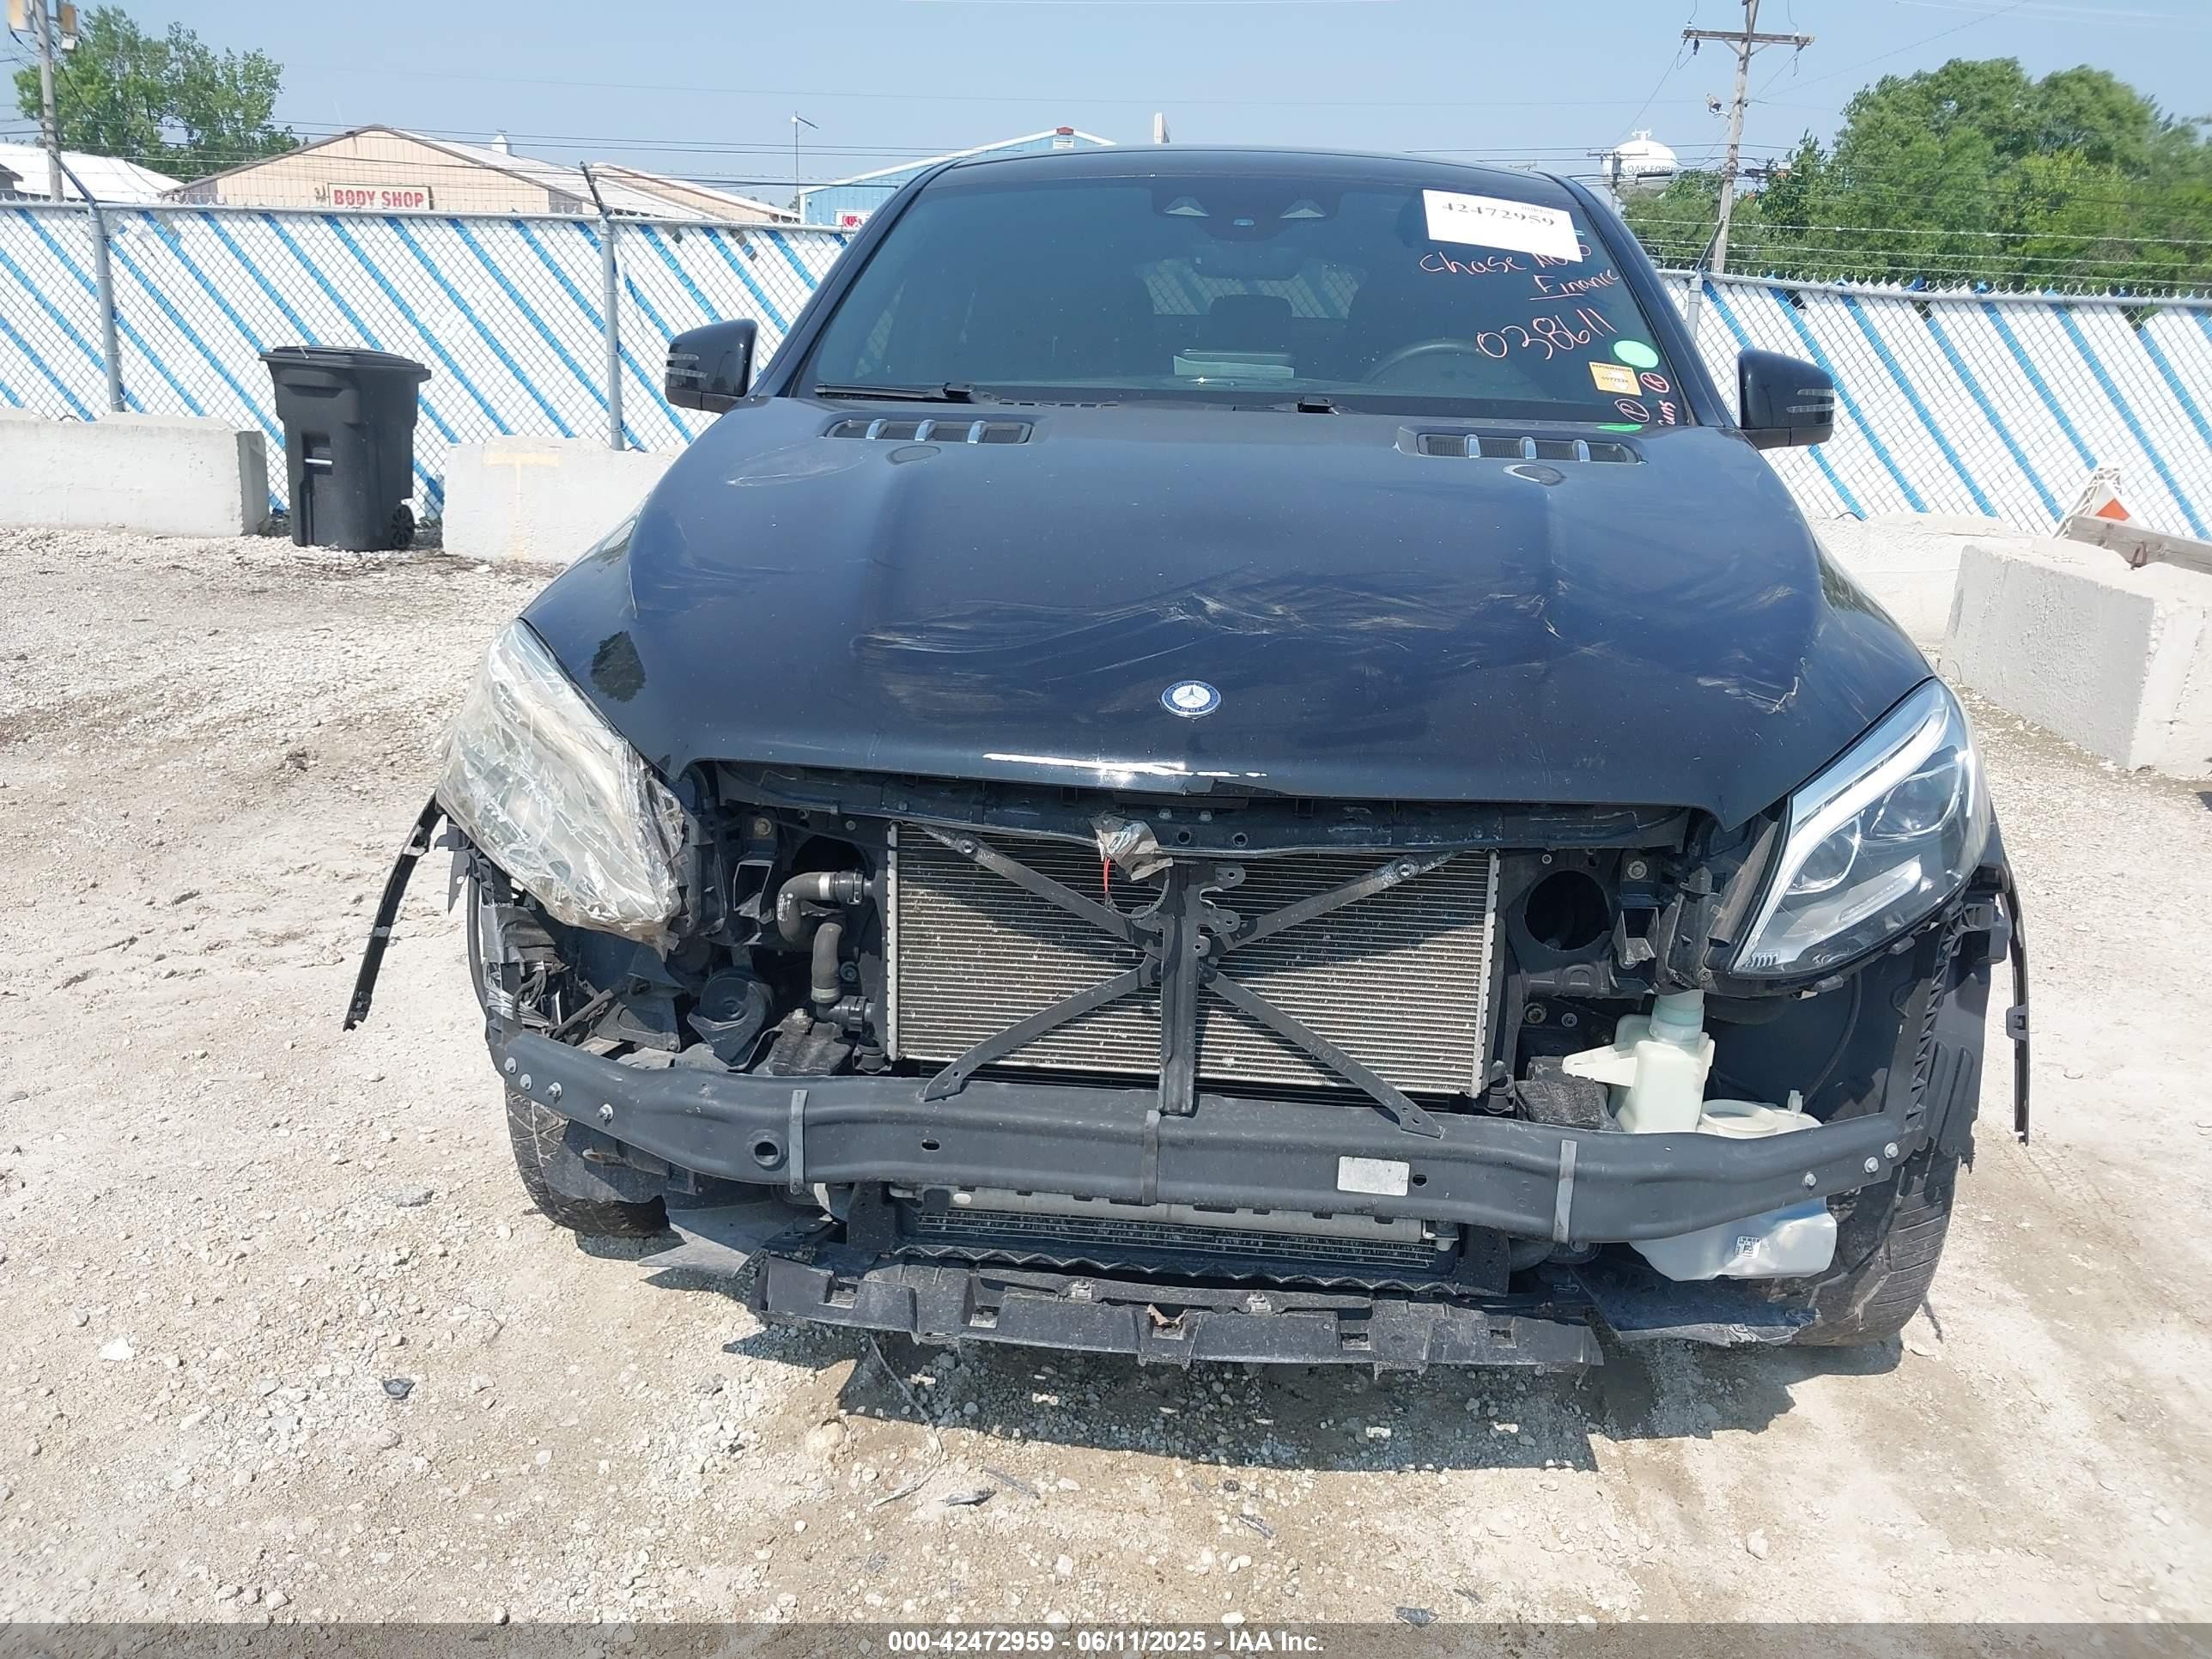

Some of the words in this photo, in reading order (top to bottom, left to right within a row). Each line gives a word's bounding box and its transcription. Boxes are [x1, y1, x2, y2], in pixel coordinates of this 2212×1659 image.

[334, 189, 375, 205] BODY
[381, 191, 424, 207] SHOP
[1443, 203, 1555, 226] 42472959
[1419, 251, 1527, 275] Chase
[1476, 307, 1618, 360] 038611
